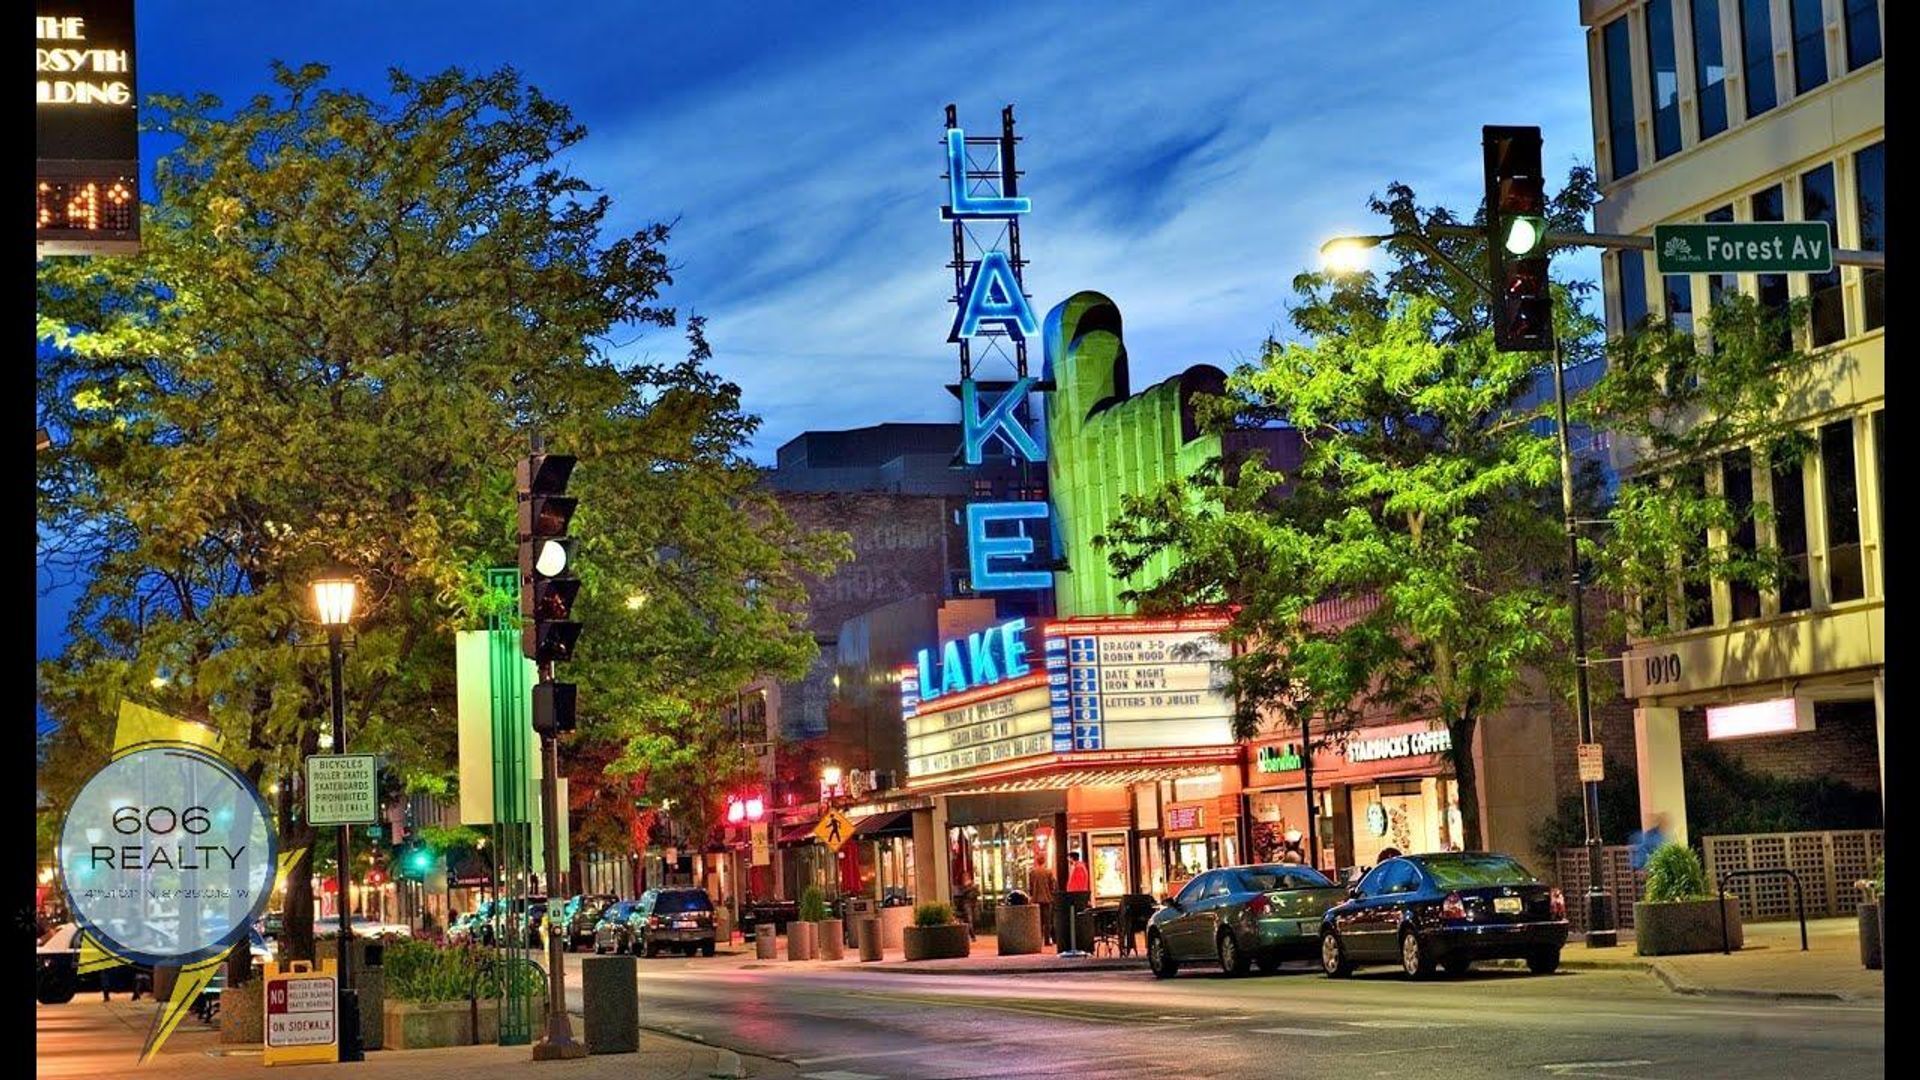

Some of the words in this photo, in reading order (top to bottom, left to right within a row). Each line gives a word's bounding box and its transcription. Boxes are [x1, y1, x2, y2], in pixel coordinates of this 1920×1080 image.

[1706, 235, 1783, 261] Forest
[1791, 235, 1823, 260] Av
[946, 128, 1054, 591] LAKE
[1103, 641, 1142, 651] DRAGON
[1148, 640, 1165, 650] 3-D
[917, 617, 1030, 701] LAKE
[1103, 653, 1133, 662] ROBIN
[1138, 651, 1164, 661] HOOD
[1105, 670, 1129, 680] DATE
[1136, 668, 1164, 679] NIGHT
[1105, 680, 1128, 690] IRON
[1135, 679, 1155, 689] MAN
[1161, 678, 1167, 688] 2
[1105, 697, 1146, 708] LETTERS
[1150, 696, 1163, 706] TO
[1166, 694, 1200, 705] JULIET
[1348, 734, 1410, 762] STARBUCKS
[320, 760, 363, 769] BICYCLES
[343, 770, 369, 779] SKATES
[315, 781, 369, 791] SKATEBOARDS
[315, 792, 369, 802] PROHIBITED
[270, 989, 285, 1005] NO
[273, 1022, 285, 1032] ON
[288, 1020, 331, 1032] SIDEWALK
